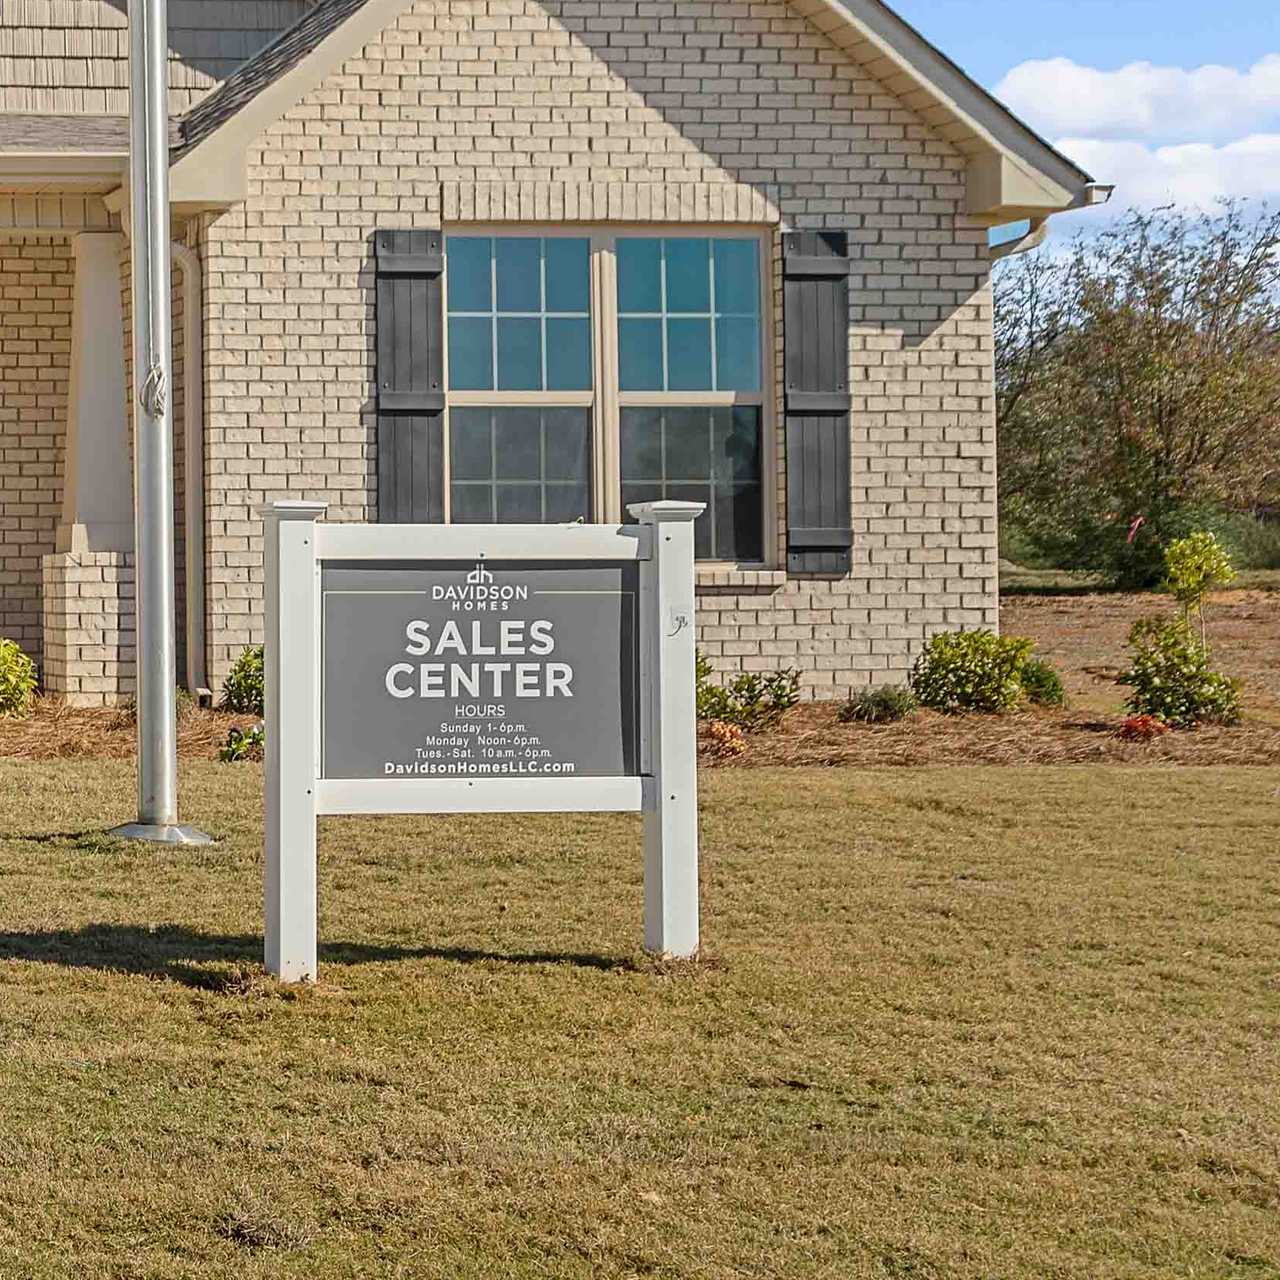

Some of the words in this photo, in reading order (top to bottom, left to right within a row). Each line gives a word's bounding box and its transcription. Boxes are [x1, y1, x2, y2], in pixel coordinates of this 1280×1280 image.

[432, 585, 528, 601] DAVIDSON
[452, 600, 509, 611] HOMES
[405, 620, 555, 656] SALES
[385, 662, 574, 699] CENTER
[455, 704, 506, 718] HOURS
[440, 722, 482, 734] Sunday
[426, 735, 470, 748] Monday
[384, 761, 575, 774] DavidsonHomesLLC.com
